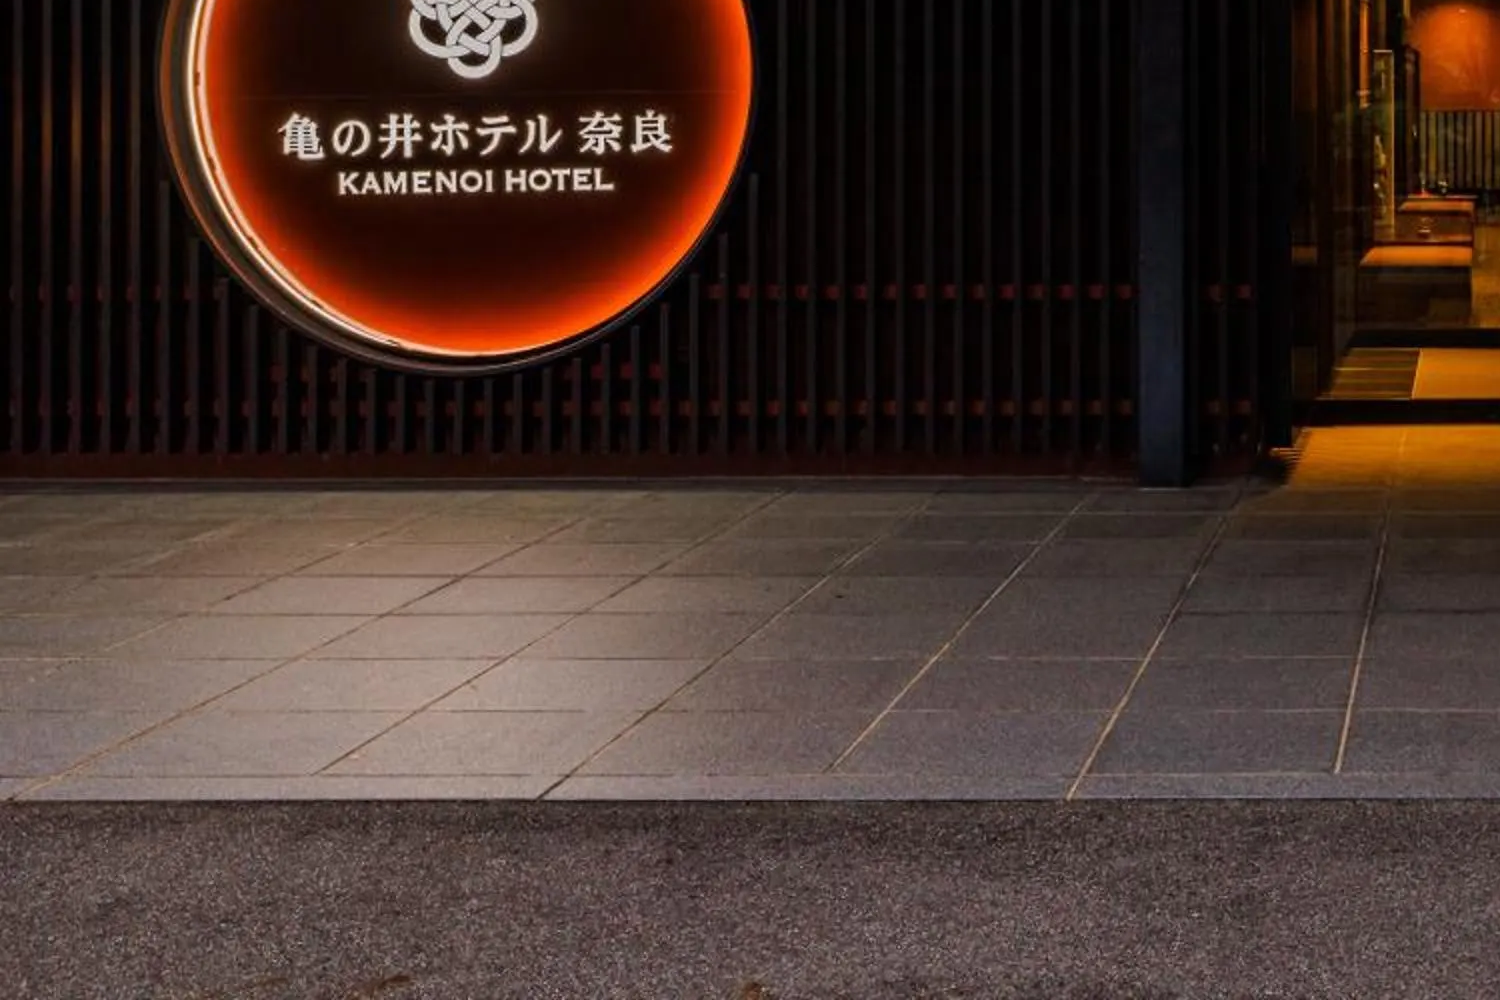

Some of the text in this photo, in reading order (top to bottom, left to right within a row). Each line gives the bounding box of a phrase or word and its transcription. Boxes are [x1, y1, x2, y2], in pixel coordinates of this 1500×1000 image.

[277, 109, 673, 160] 亀の井ホテル 奈良
[338, 167, 615, 195] KAMENOI HOTEL
